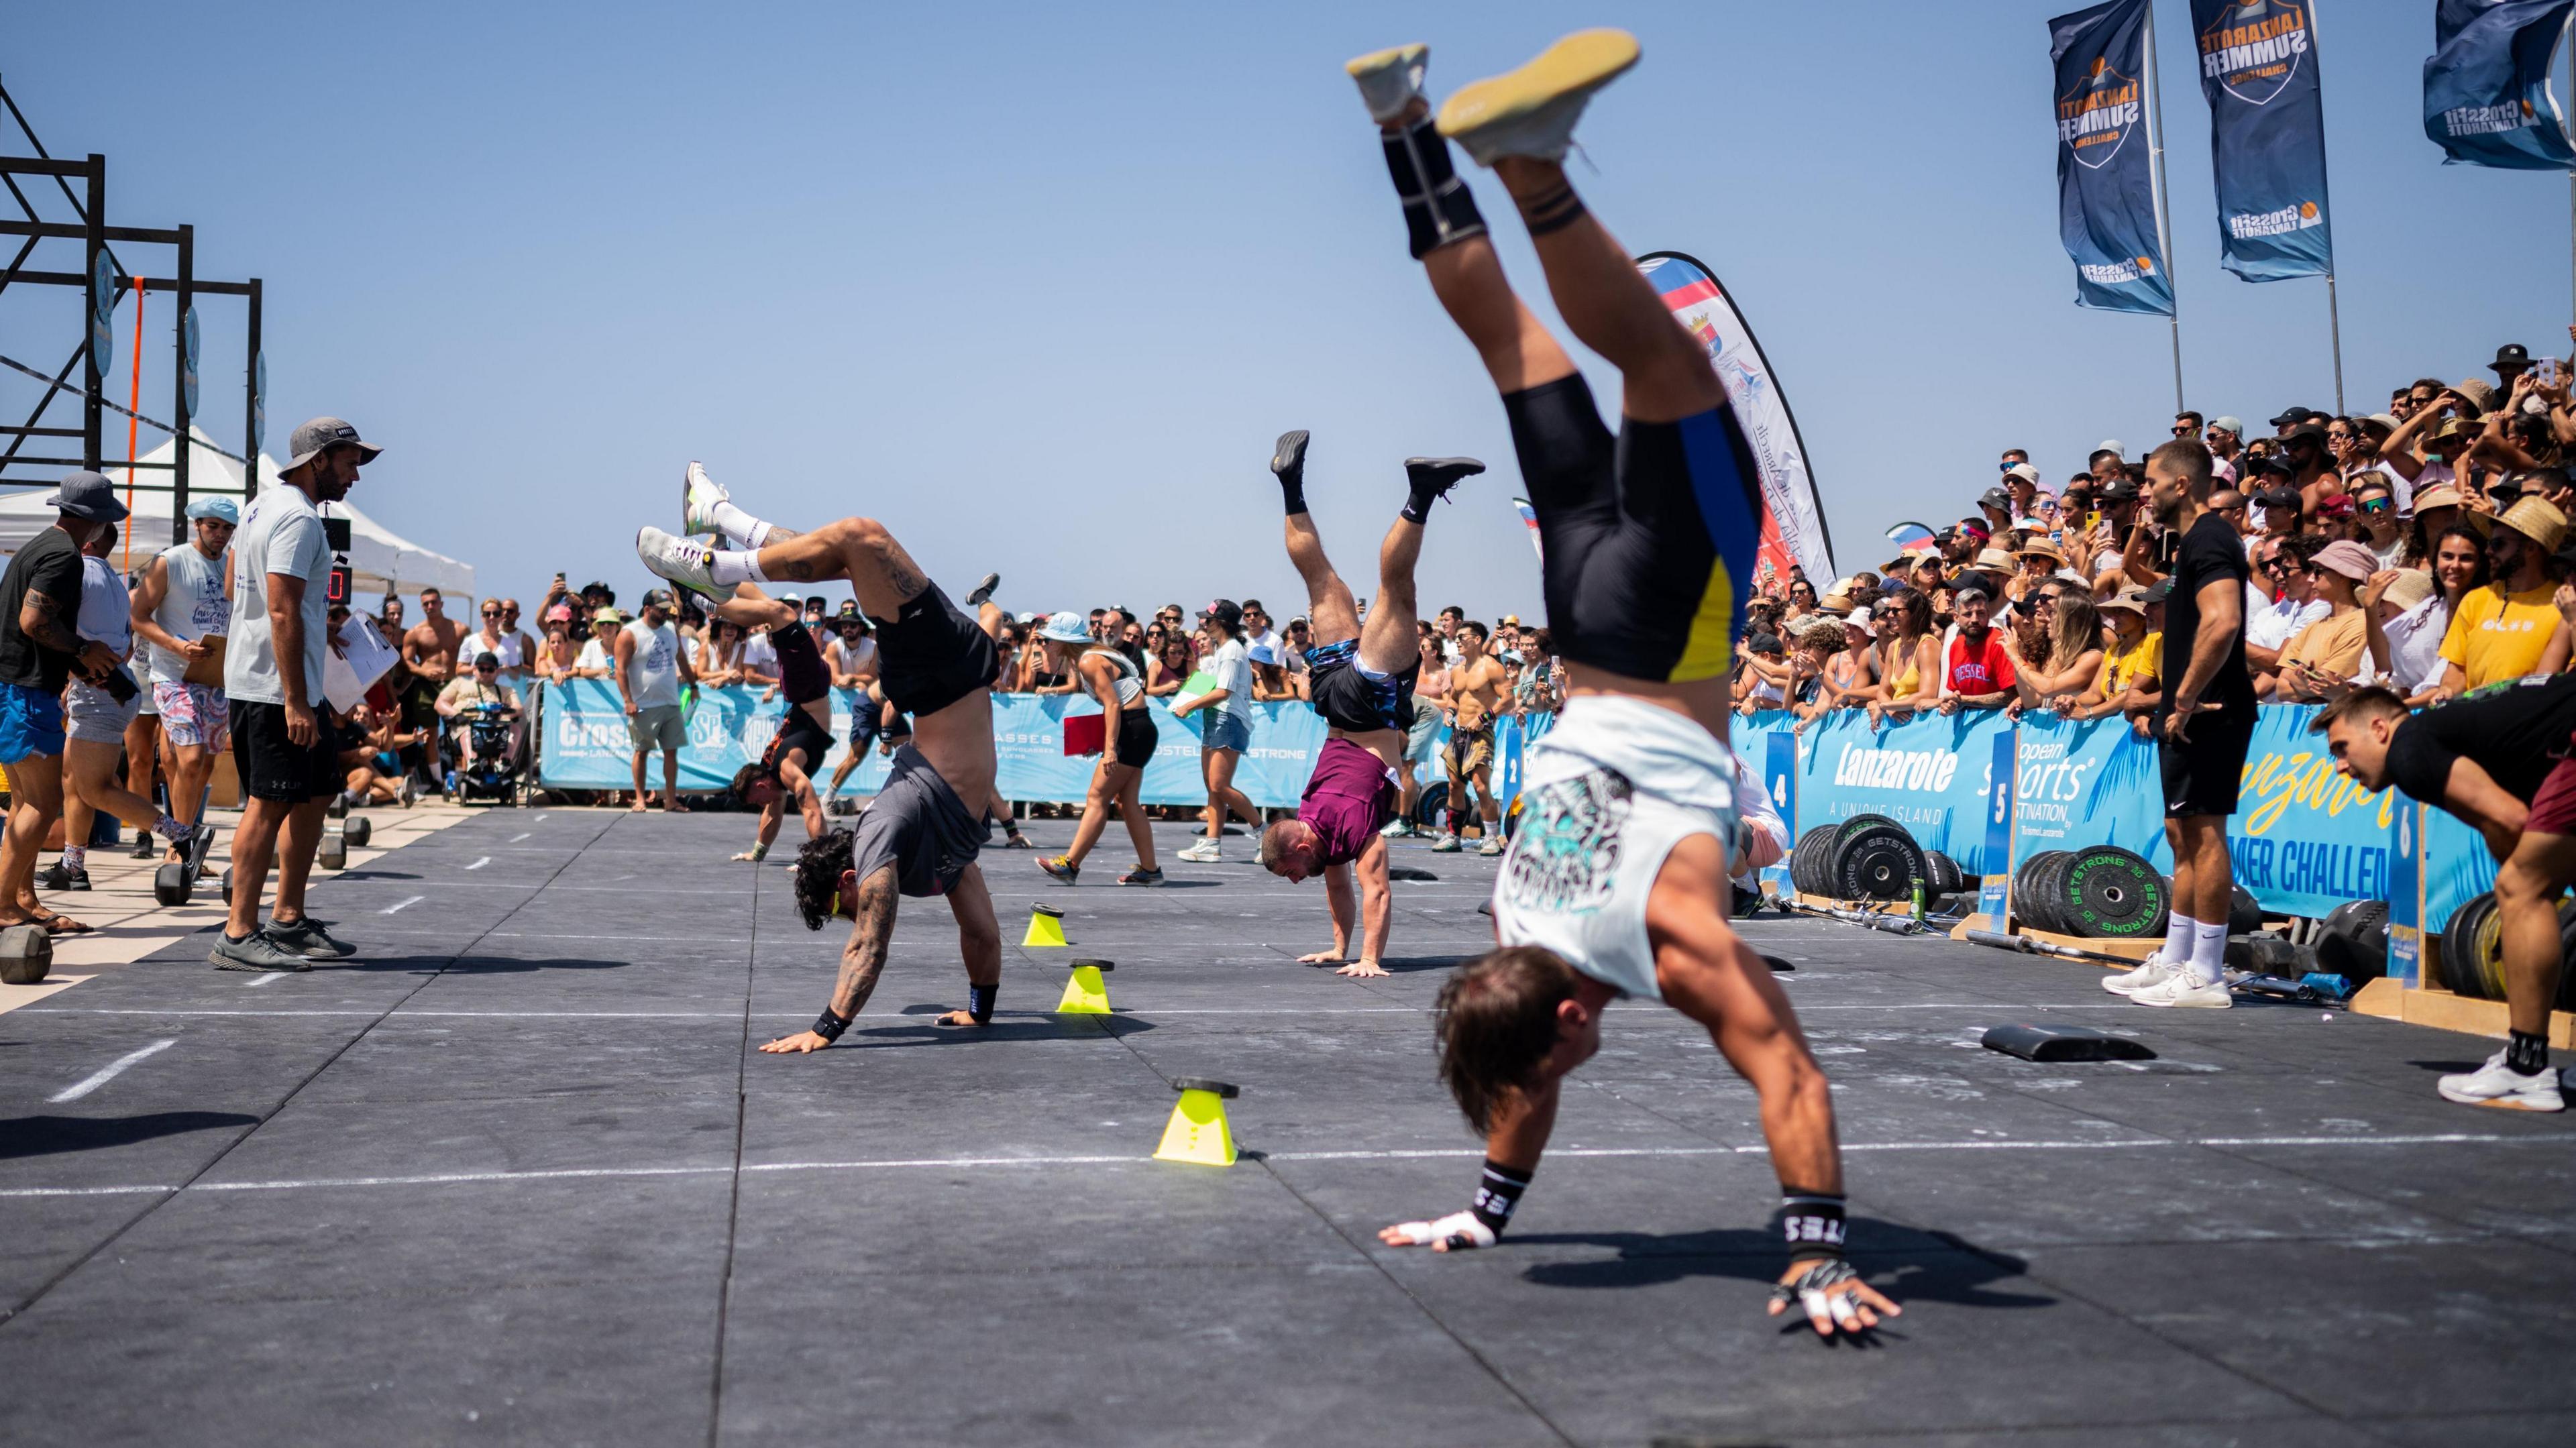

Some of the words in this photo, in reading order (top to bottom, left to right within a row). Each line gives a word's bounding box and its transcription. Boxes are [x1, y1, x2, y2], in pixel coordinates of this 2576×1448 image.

[1509, 759, 1518, 783] 2
[1834, 741, 1959, 793] Lanzarote
[1774, 774, 1787, 807] 4
[1829, 801, 1836, 816] A
[1891, 805, 1943, 825] ISLAND
[1994, 783, 2006, 824] 5
[2399, 805, 2411, 858] 6
[2071, 856, 2126, 905] GETSTRONG
[2101, 883, 2158, 934] GETSTRONG
